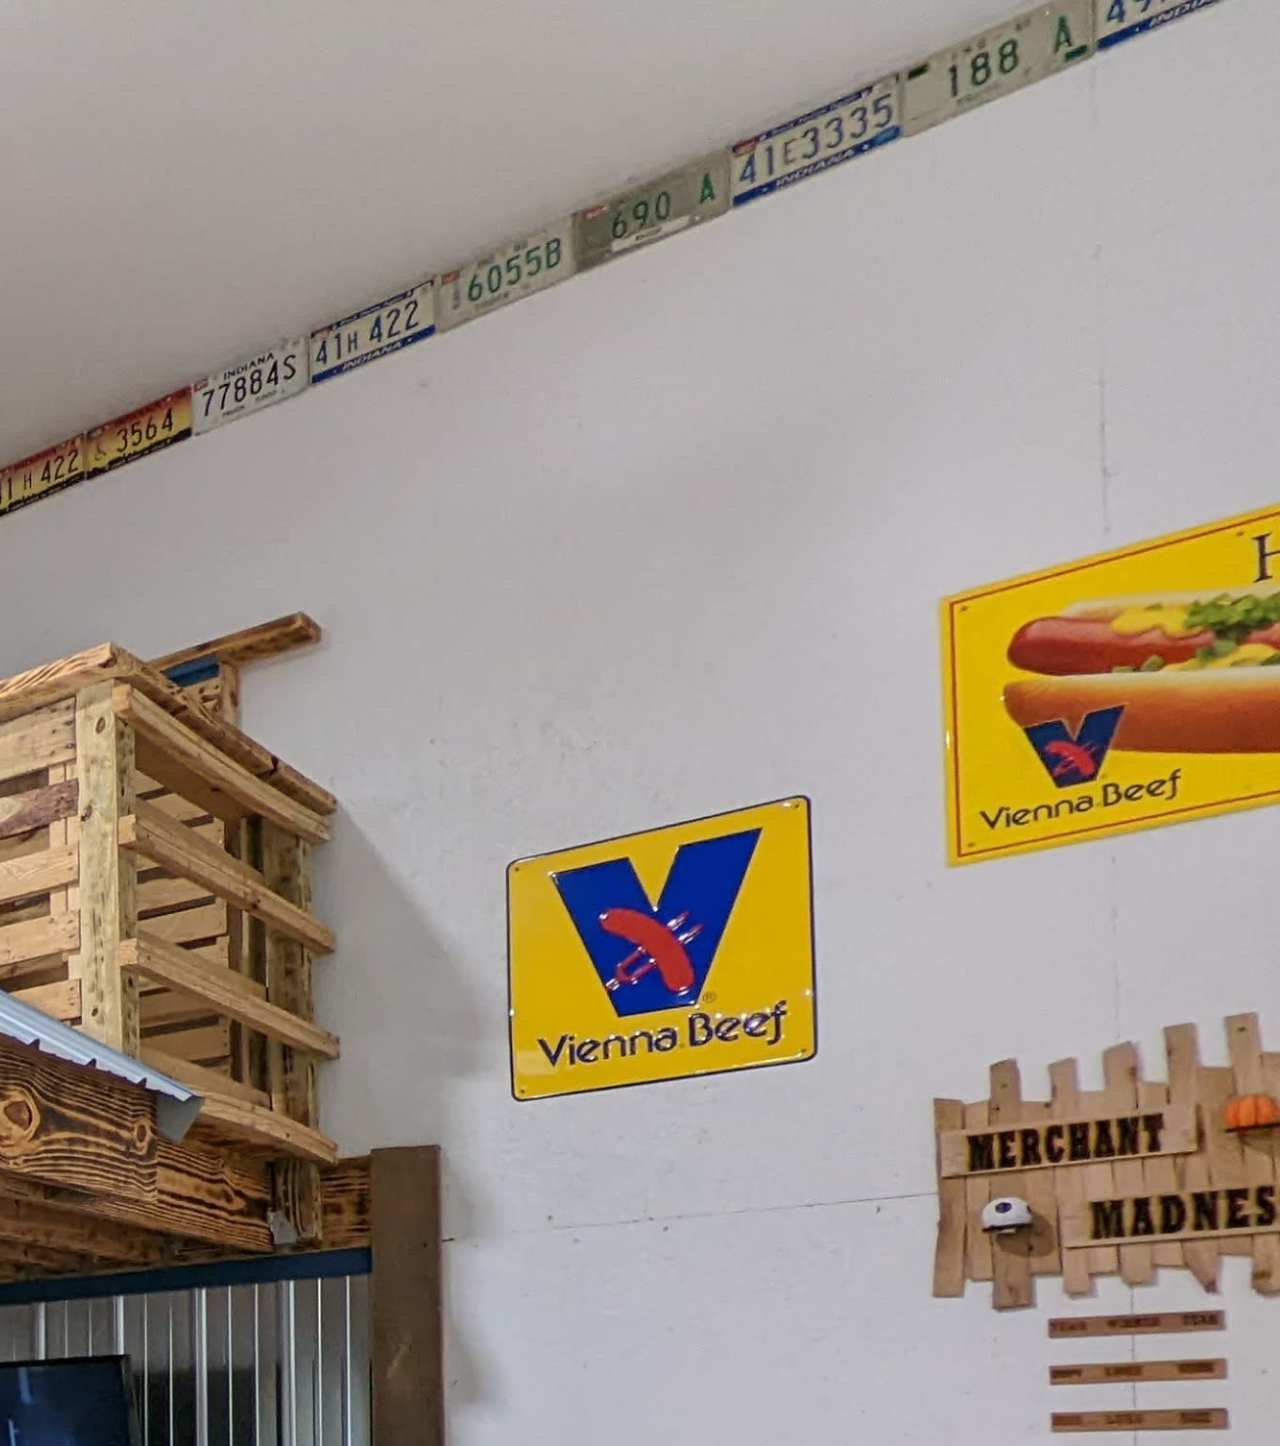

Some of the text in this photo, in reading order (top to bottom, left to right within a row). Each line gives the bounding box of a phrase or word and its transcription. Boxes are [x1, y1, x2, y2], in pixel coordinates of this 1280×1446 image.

[948, 38, 1019, 97] 188
[1053, 15, 1073, 53] A
[739, 93, 894, 184] 41E3335
[611, 172, 717, 240] 690 A
[468, 237, 561, 302] 6055B
[202, 354, 297, 417] 77884S
[223, 352, 275, 380] INDIANA
[116, 407, 173, 453] 3564
[40, 449, 79, 484] 422
[980, 768, 1182, 829] Vienna Beef
[537, 999, 787, 1066] Vienna Beef
[966, 1113, 1164, 1172] MERCHANT
